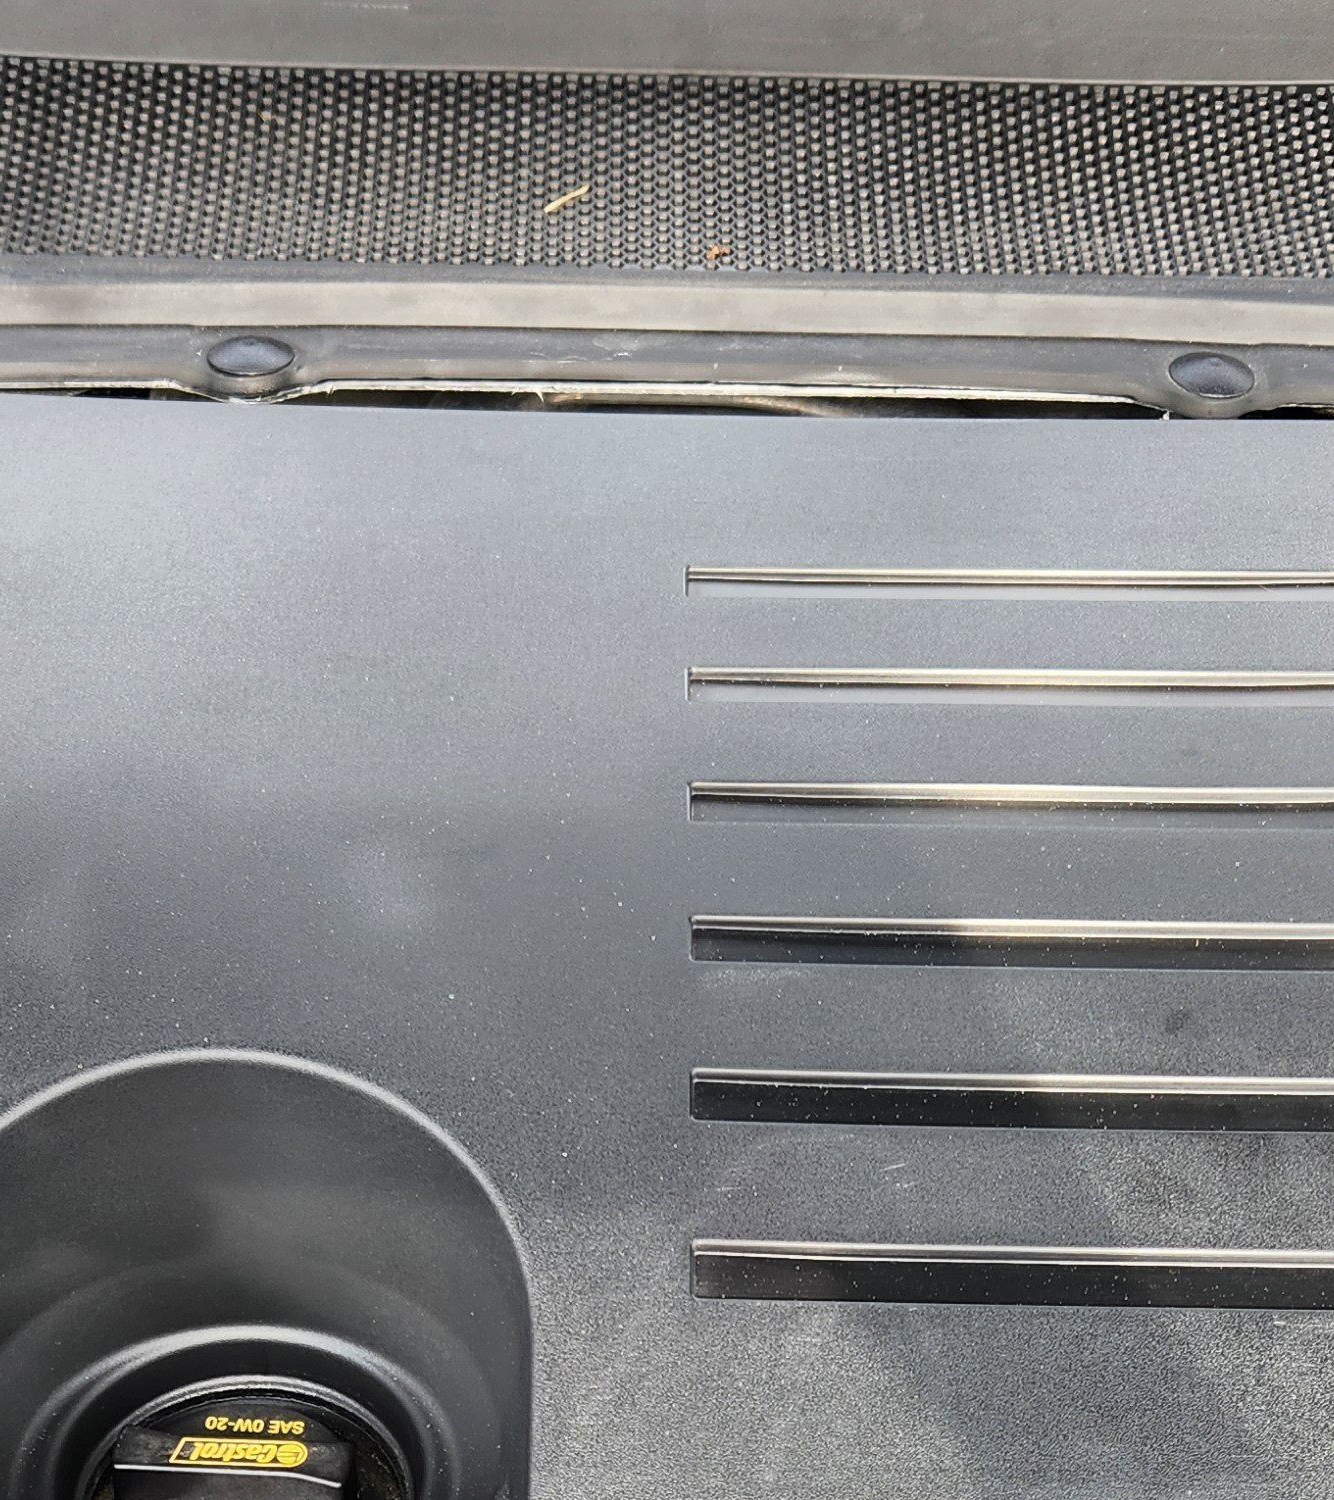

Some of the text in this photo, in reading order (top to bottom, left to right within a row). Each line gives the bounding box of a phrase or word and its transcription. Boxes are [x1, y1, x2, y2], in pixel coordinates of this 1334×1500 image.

[204, 1415, 306, 1435] SAE 0W-20
[189, 1442, 278, 1463] Castrol
